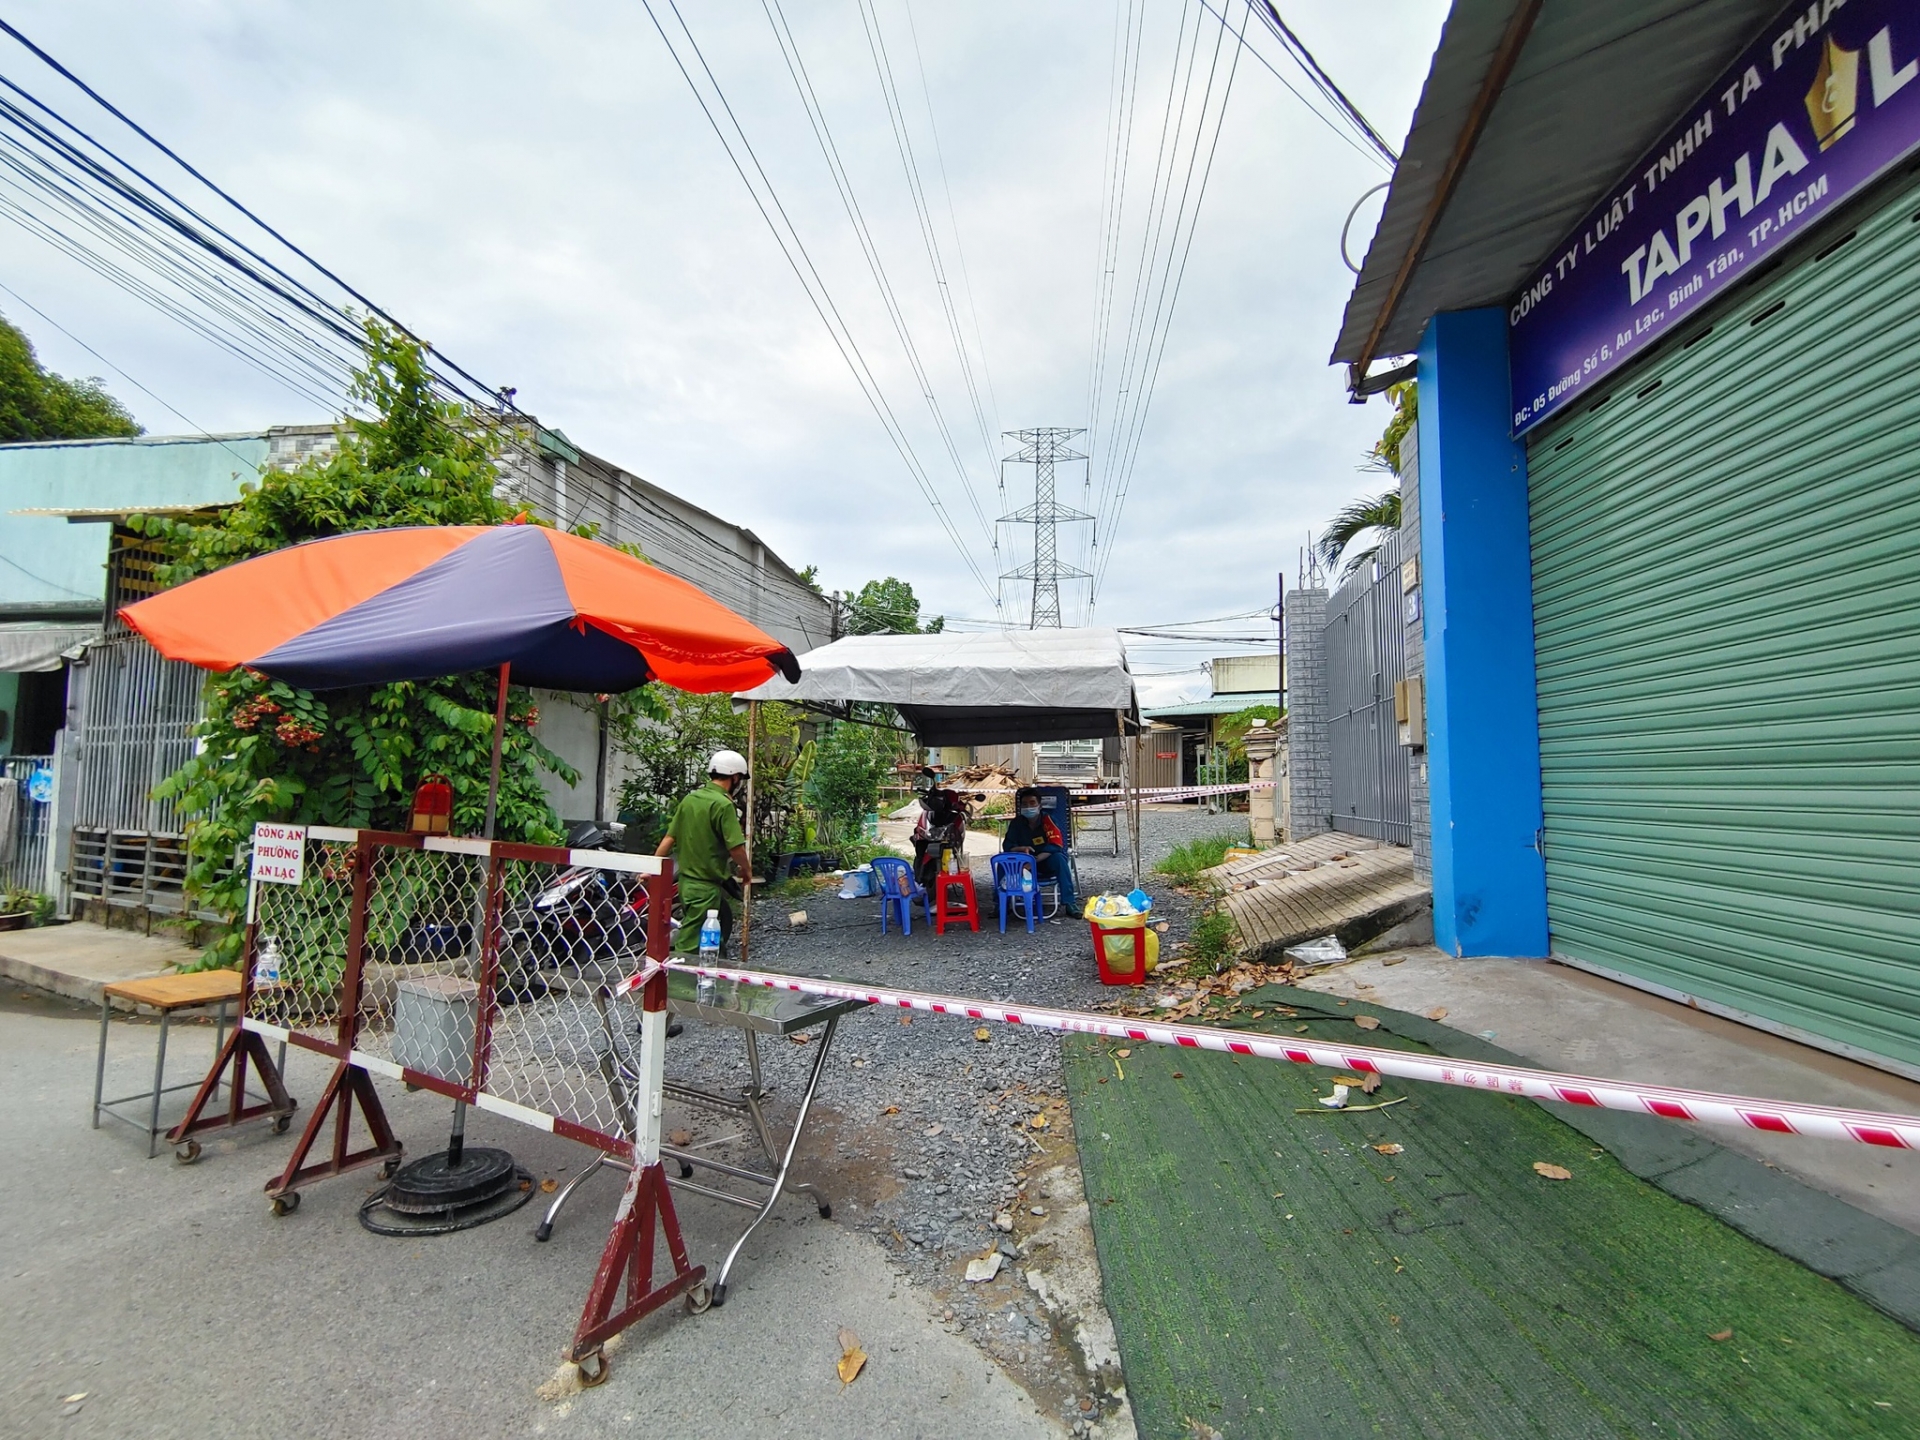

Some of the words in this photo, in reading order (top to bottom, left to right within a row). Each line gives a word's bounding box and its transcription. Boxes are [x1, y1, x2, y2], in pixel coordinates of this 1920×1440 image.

[1510, 273, 1553, 326] CÔNG
[1556, 243, 1578, 281] TY
[1585, 183, 1637, 255] LUẬT
[1643, 109, 1713, 193] TNHH
[1720, 64, 1763, 117] TA
[1621, 121, 1809, 307] TAPHA
[1515, 407, 1531, 427] ĐC:
[1533, 393, 1546, 413] 05
[1548, 368, 1581, 401] Đường
[1583, 349, 1598, 375] Số
[1601, 344, 1613, 362] 6,
[1616, 328, 1632, 351] An
[1635, 308, 1665, 336] Lạc,
[1668, 273, 1703, 310] Bình
[1706, 248, 1744, 280] Tân,
[1748, 174, 1829, 248] TP.HCM
[1408, 596, 1416, 616] 3
[258, 825, 284, 839] CÔNG
[287, 830, 303, 841] AN
[257, 845, 299, 859] PHƯỜNG
[257, 865, 272, 876] AN
[274, 867, 296, 880] LẠC
